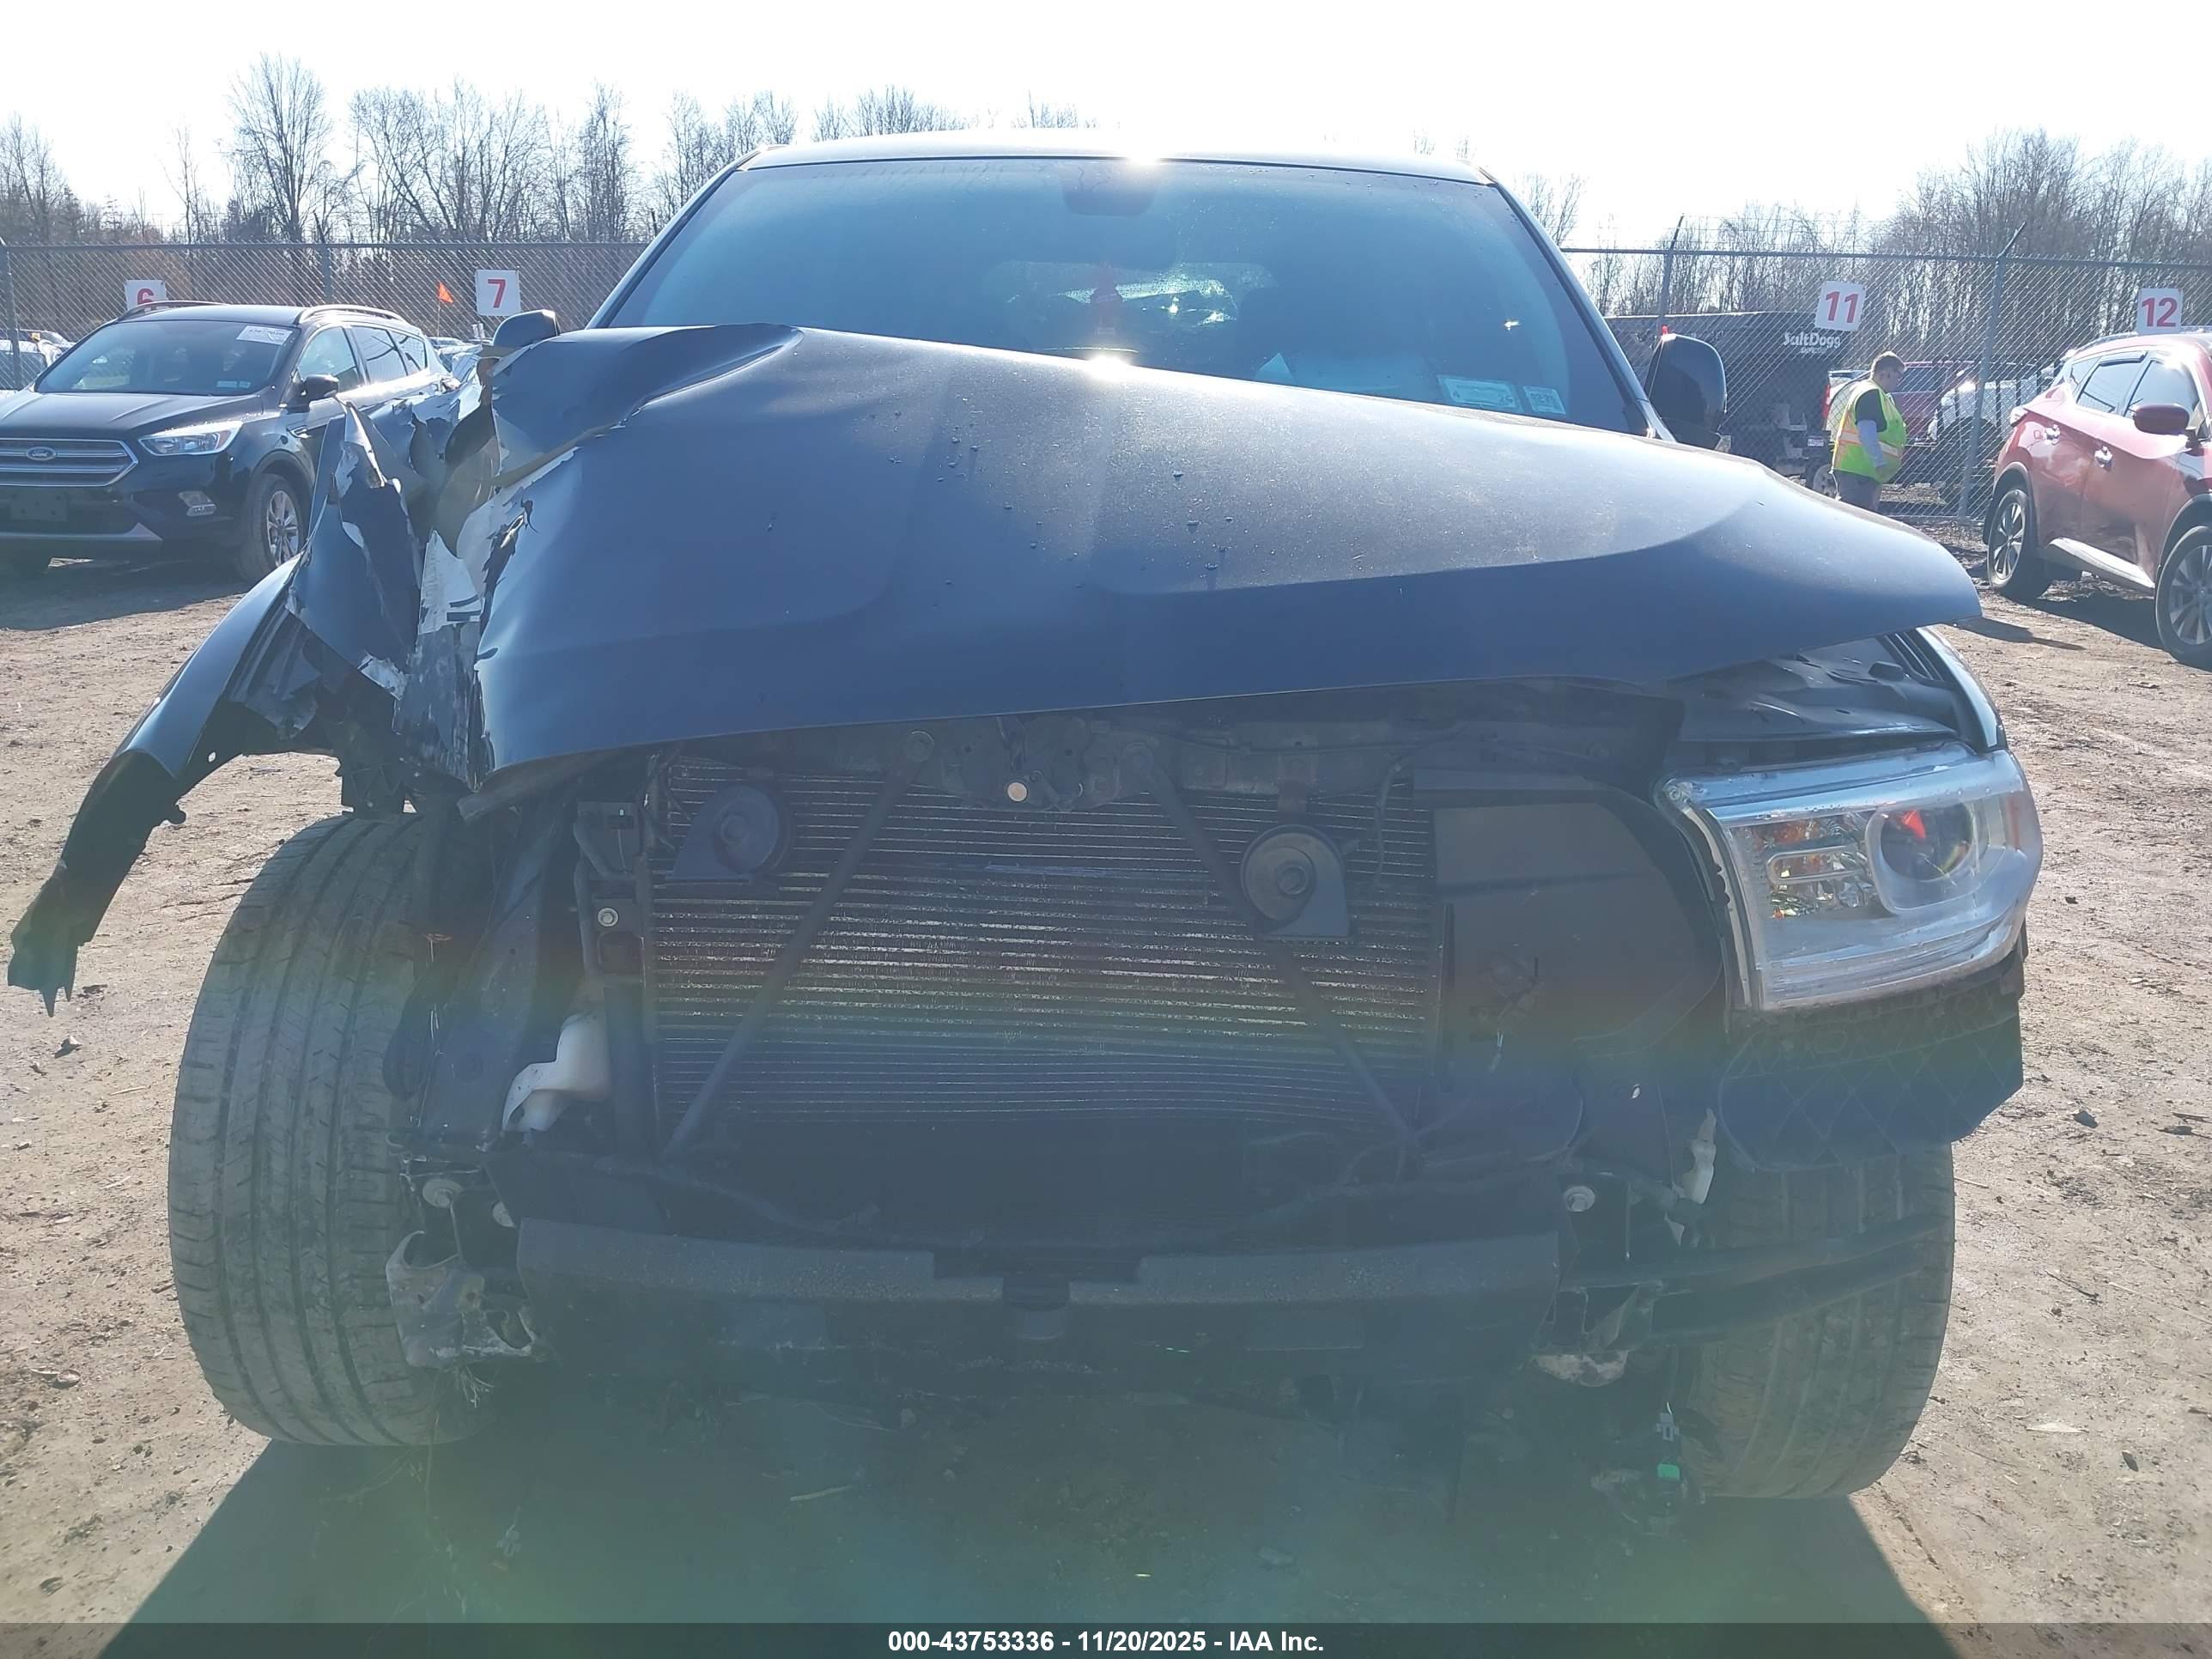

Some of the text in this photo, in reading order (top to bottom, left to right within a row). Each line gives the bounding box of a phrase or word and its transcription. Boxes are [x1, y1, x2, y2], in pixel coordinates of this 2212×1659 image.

[488, 279, 506, 308] 7
[1826, 291, 1859, 323] 11
[2142, 297, 2177, 326] 12
[1783, 331, 1841, 349] SaltDogg
